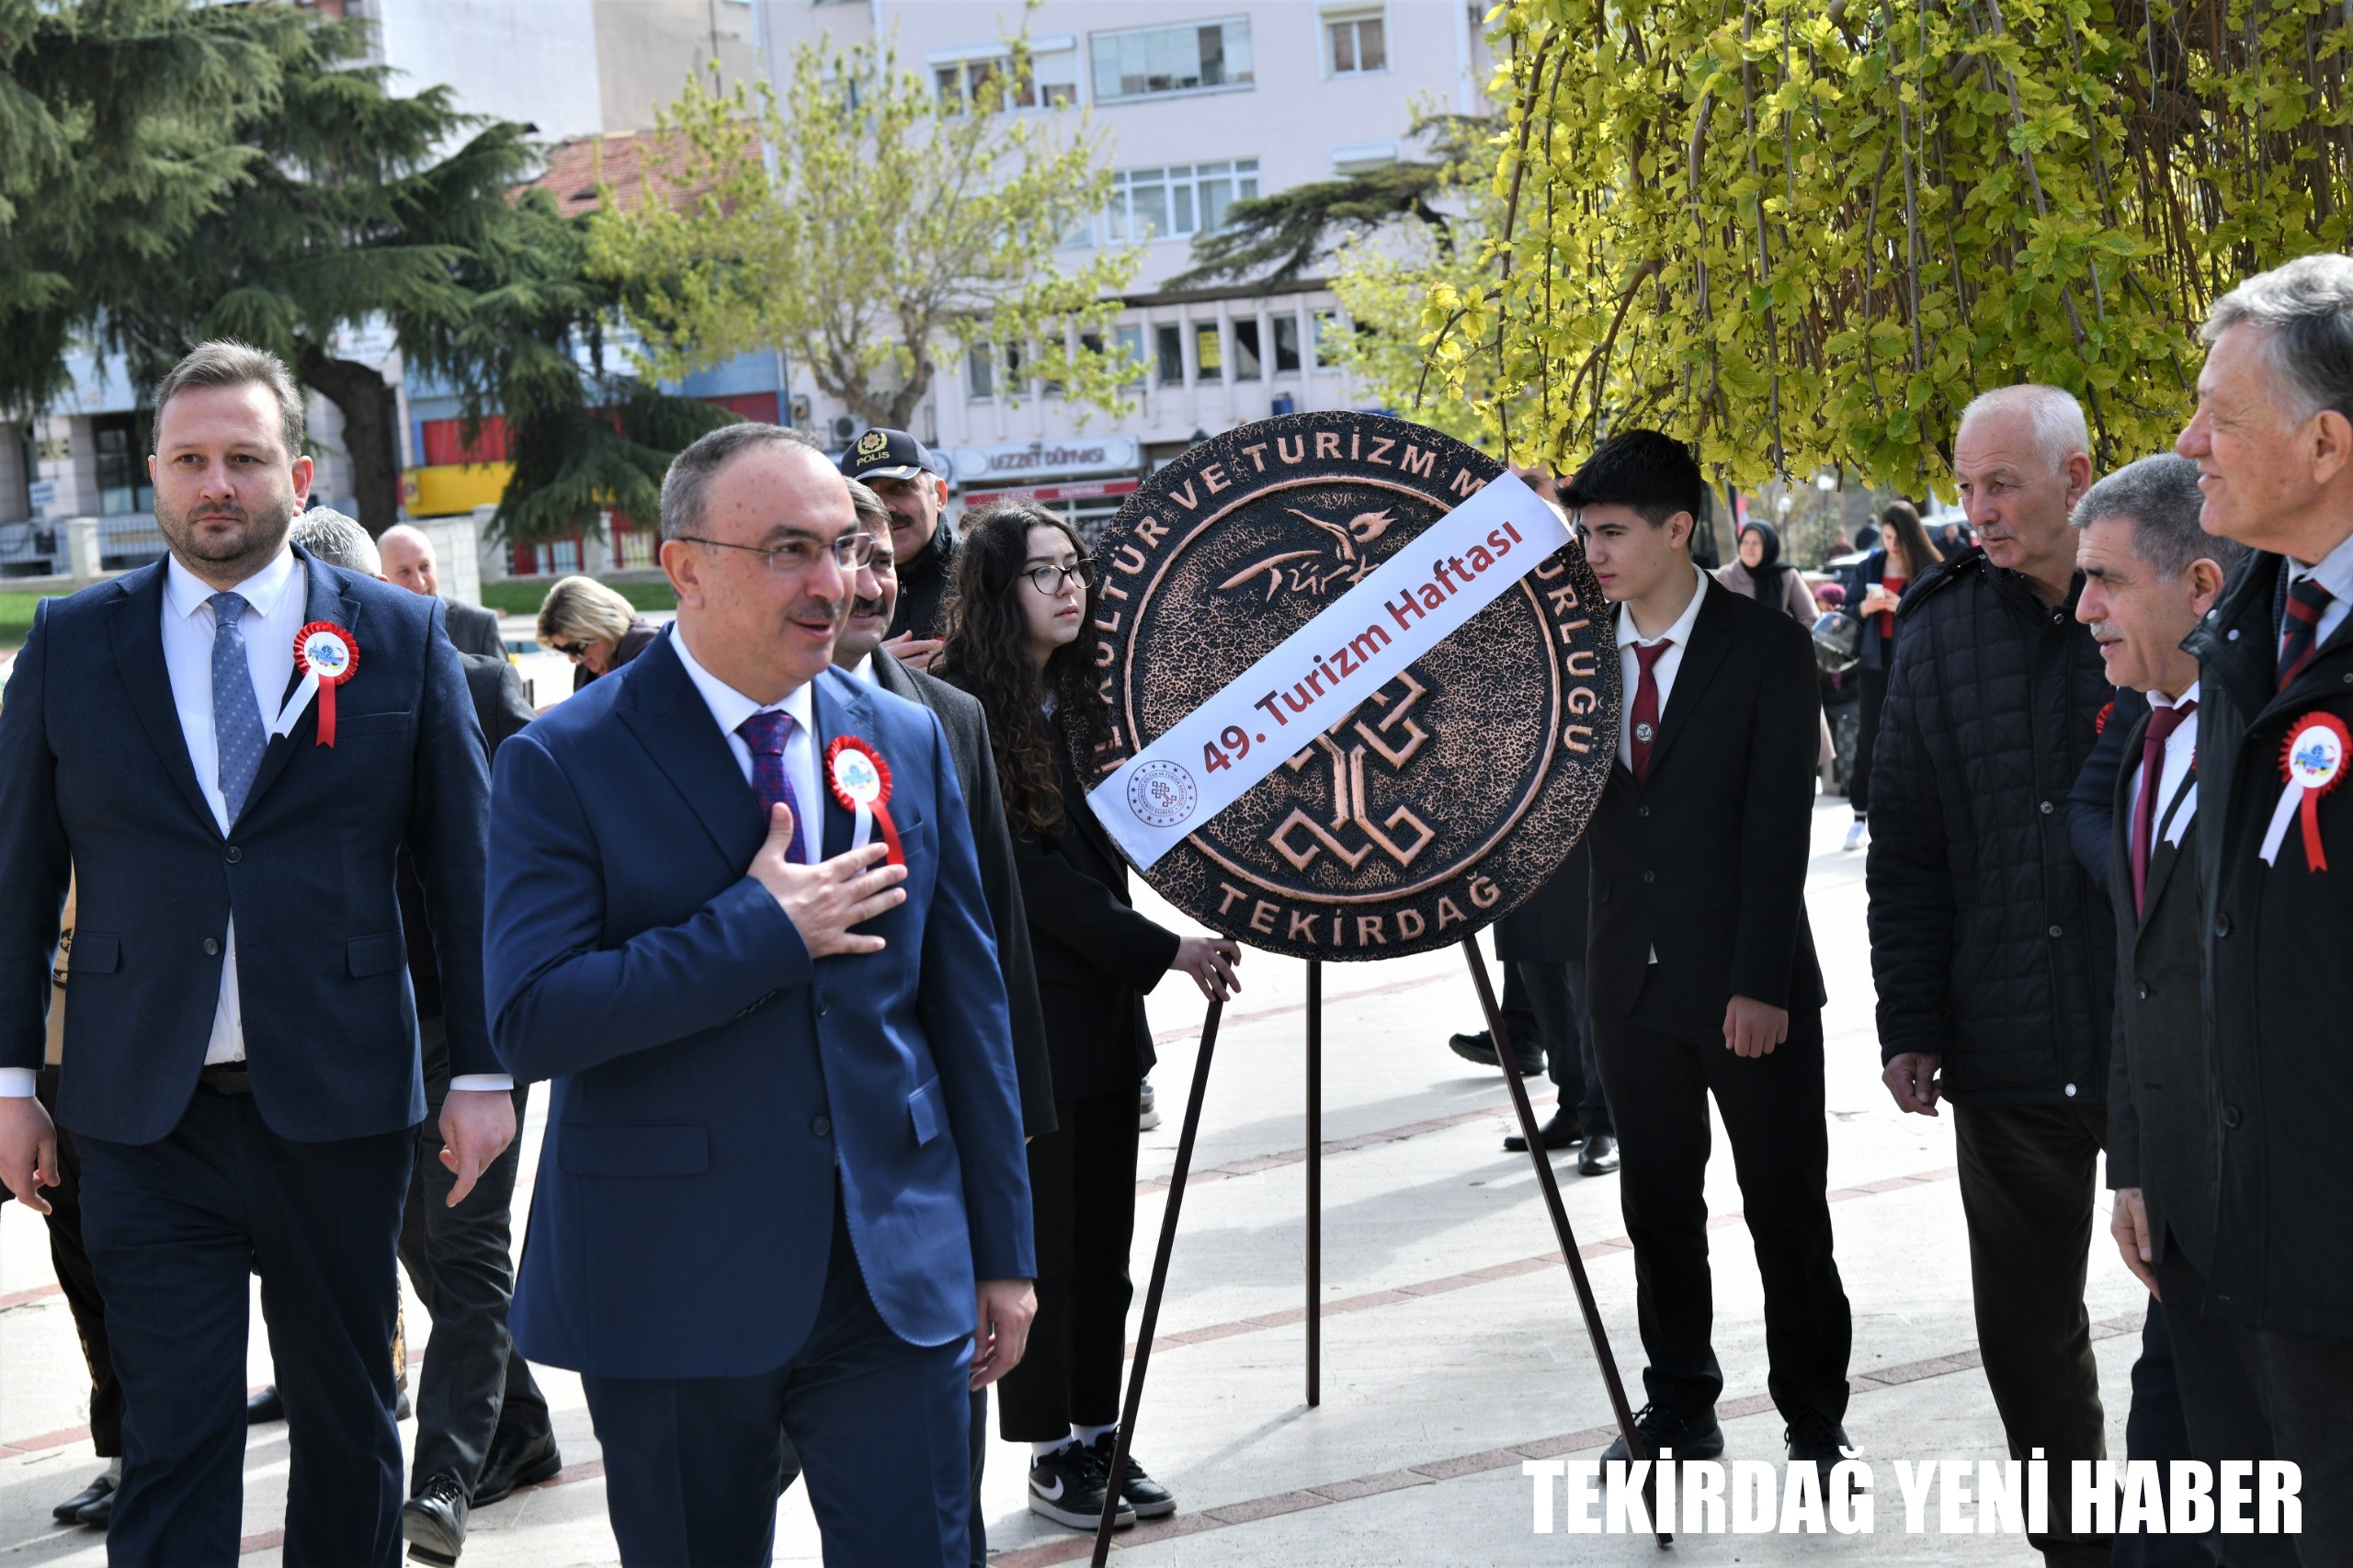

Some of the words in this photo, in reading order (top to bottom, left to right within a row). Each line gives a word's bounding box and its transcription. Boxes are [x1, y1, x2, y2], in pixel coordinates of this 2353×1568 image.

[1170, 464, 1233, 512] VE
[1241, 426, 1437, 479] TURİZM
[1449, 468, 1606, 754] MÜRLÜĞÜ
[1202, 724, 1266, 776] 49.
[1254, 623, 1393, 728] Turizm
[1383, 520, 1523, 632] Haftası
[1218, 869, 1501, 947] TEKİRDAĞ
